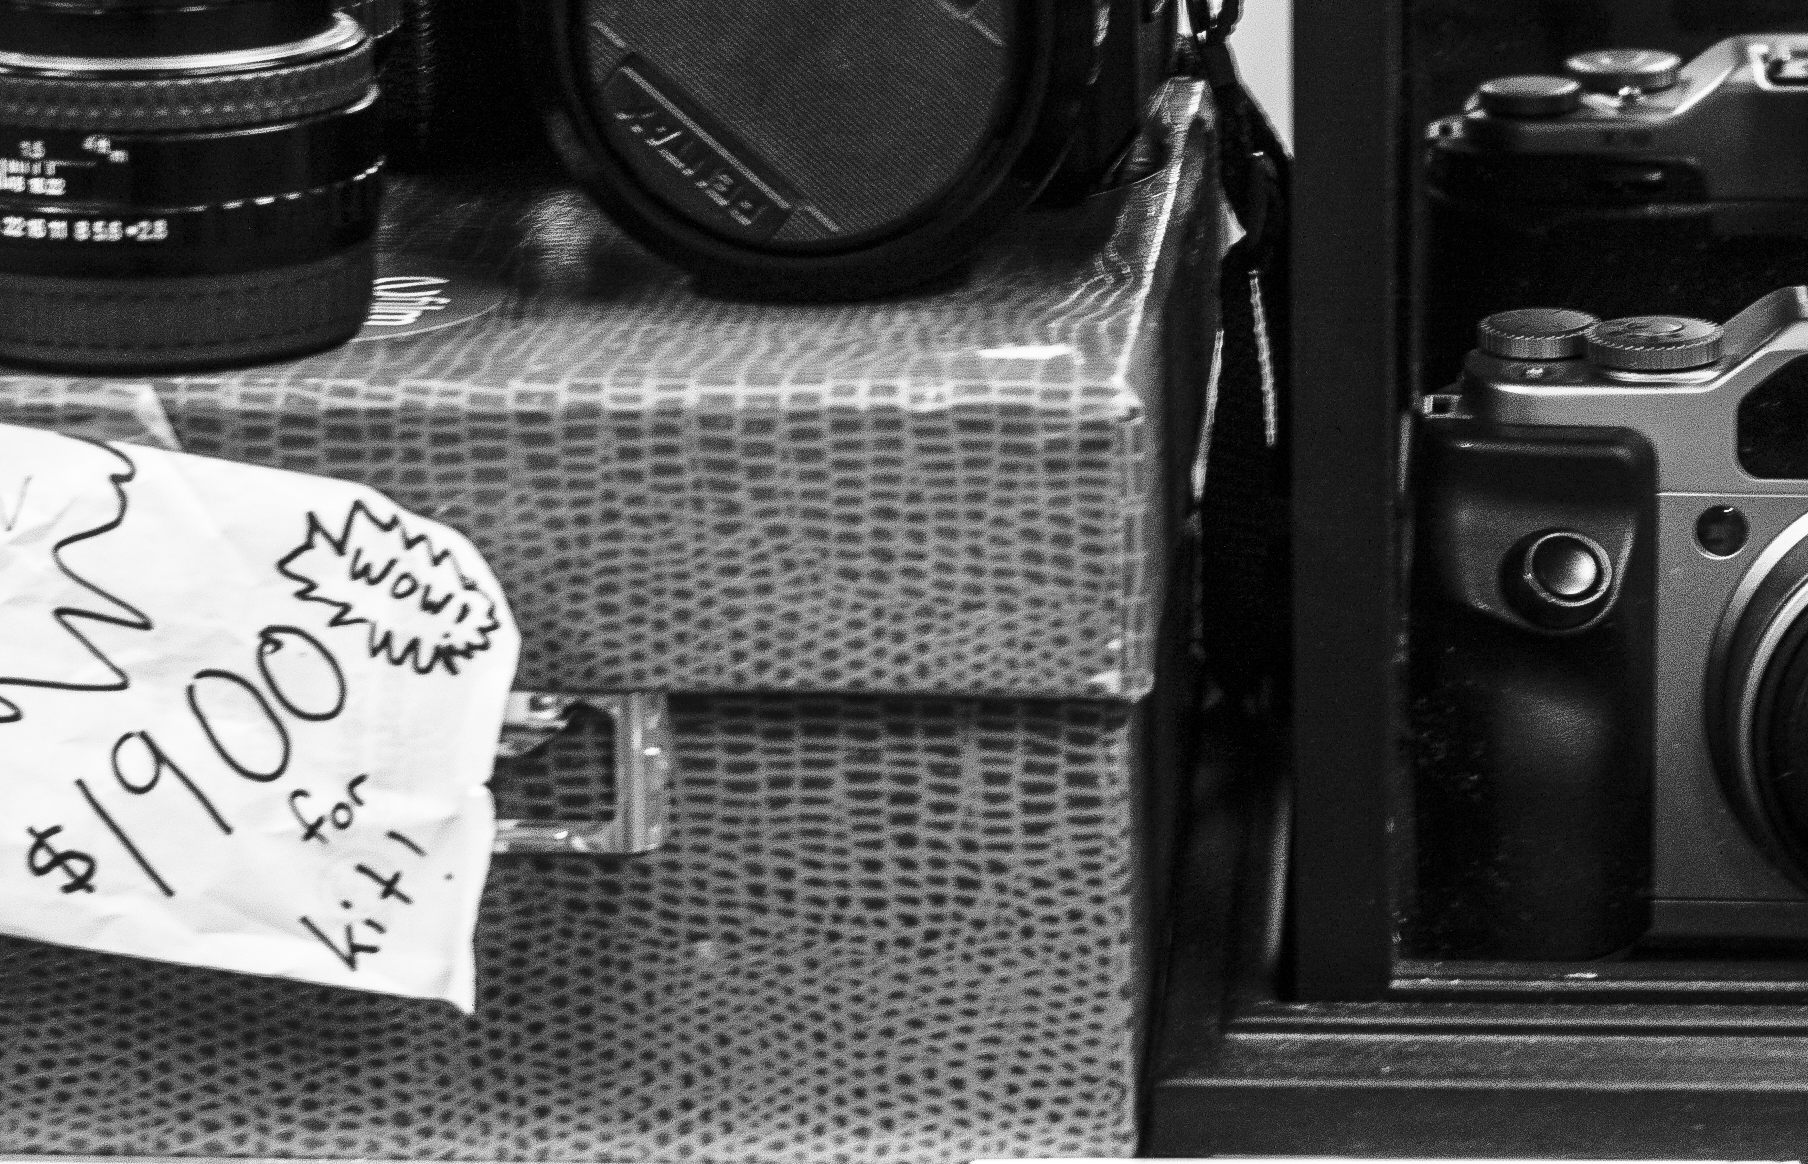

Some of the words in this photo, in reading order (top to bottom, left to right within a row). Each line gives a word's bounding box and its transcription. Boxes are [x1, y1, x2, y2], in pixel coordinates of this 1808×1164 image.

[613, 97, 770, 230] PENTAX
[25, 623, 350, 898] $1900
[284, 773, 371, 843] for
